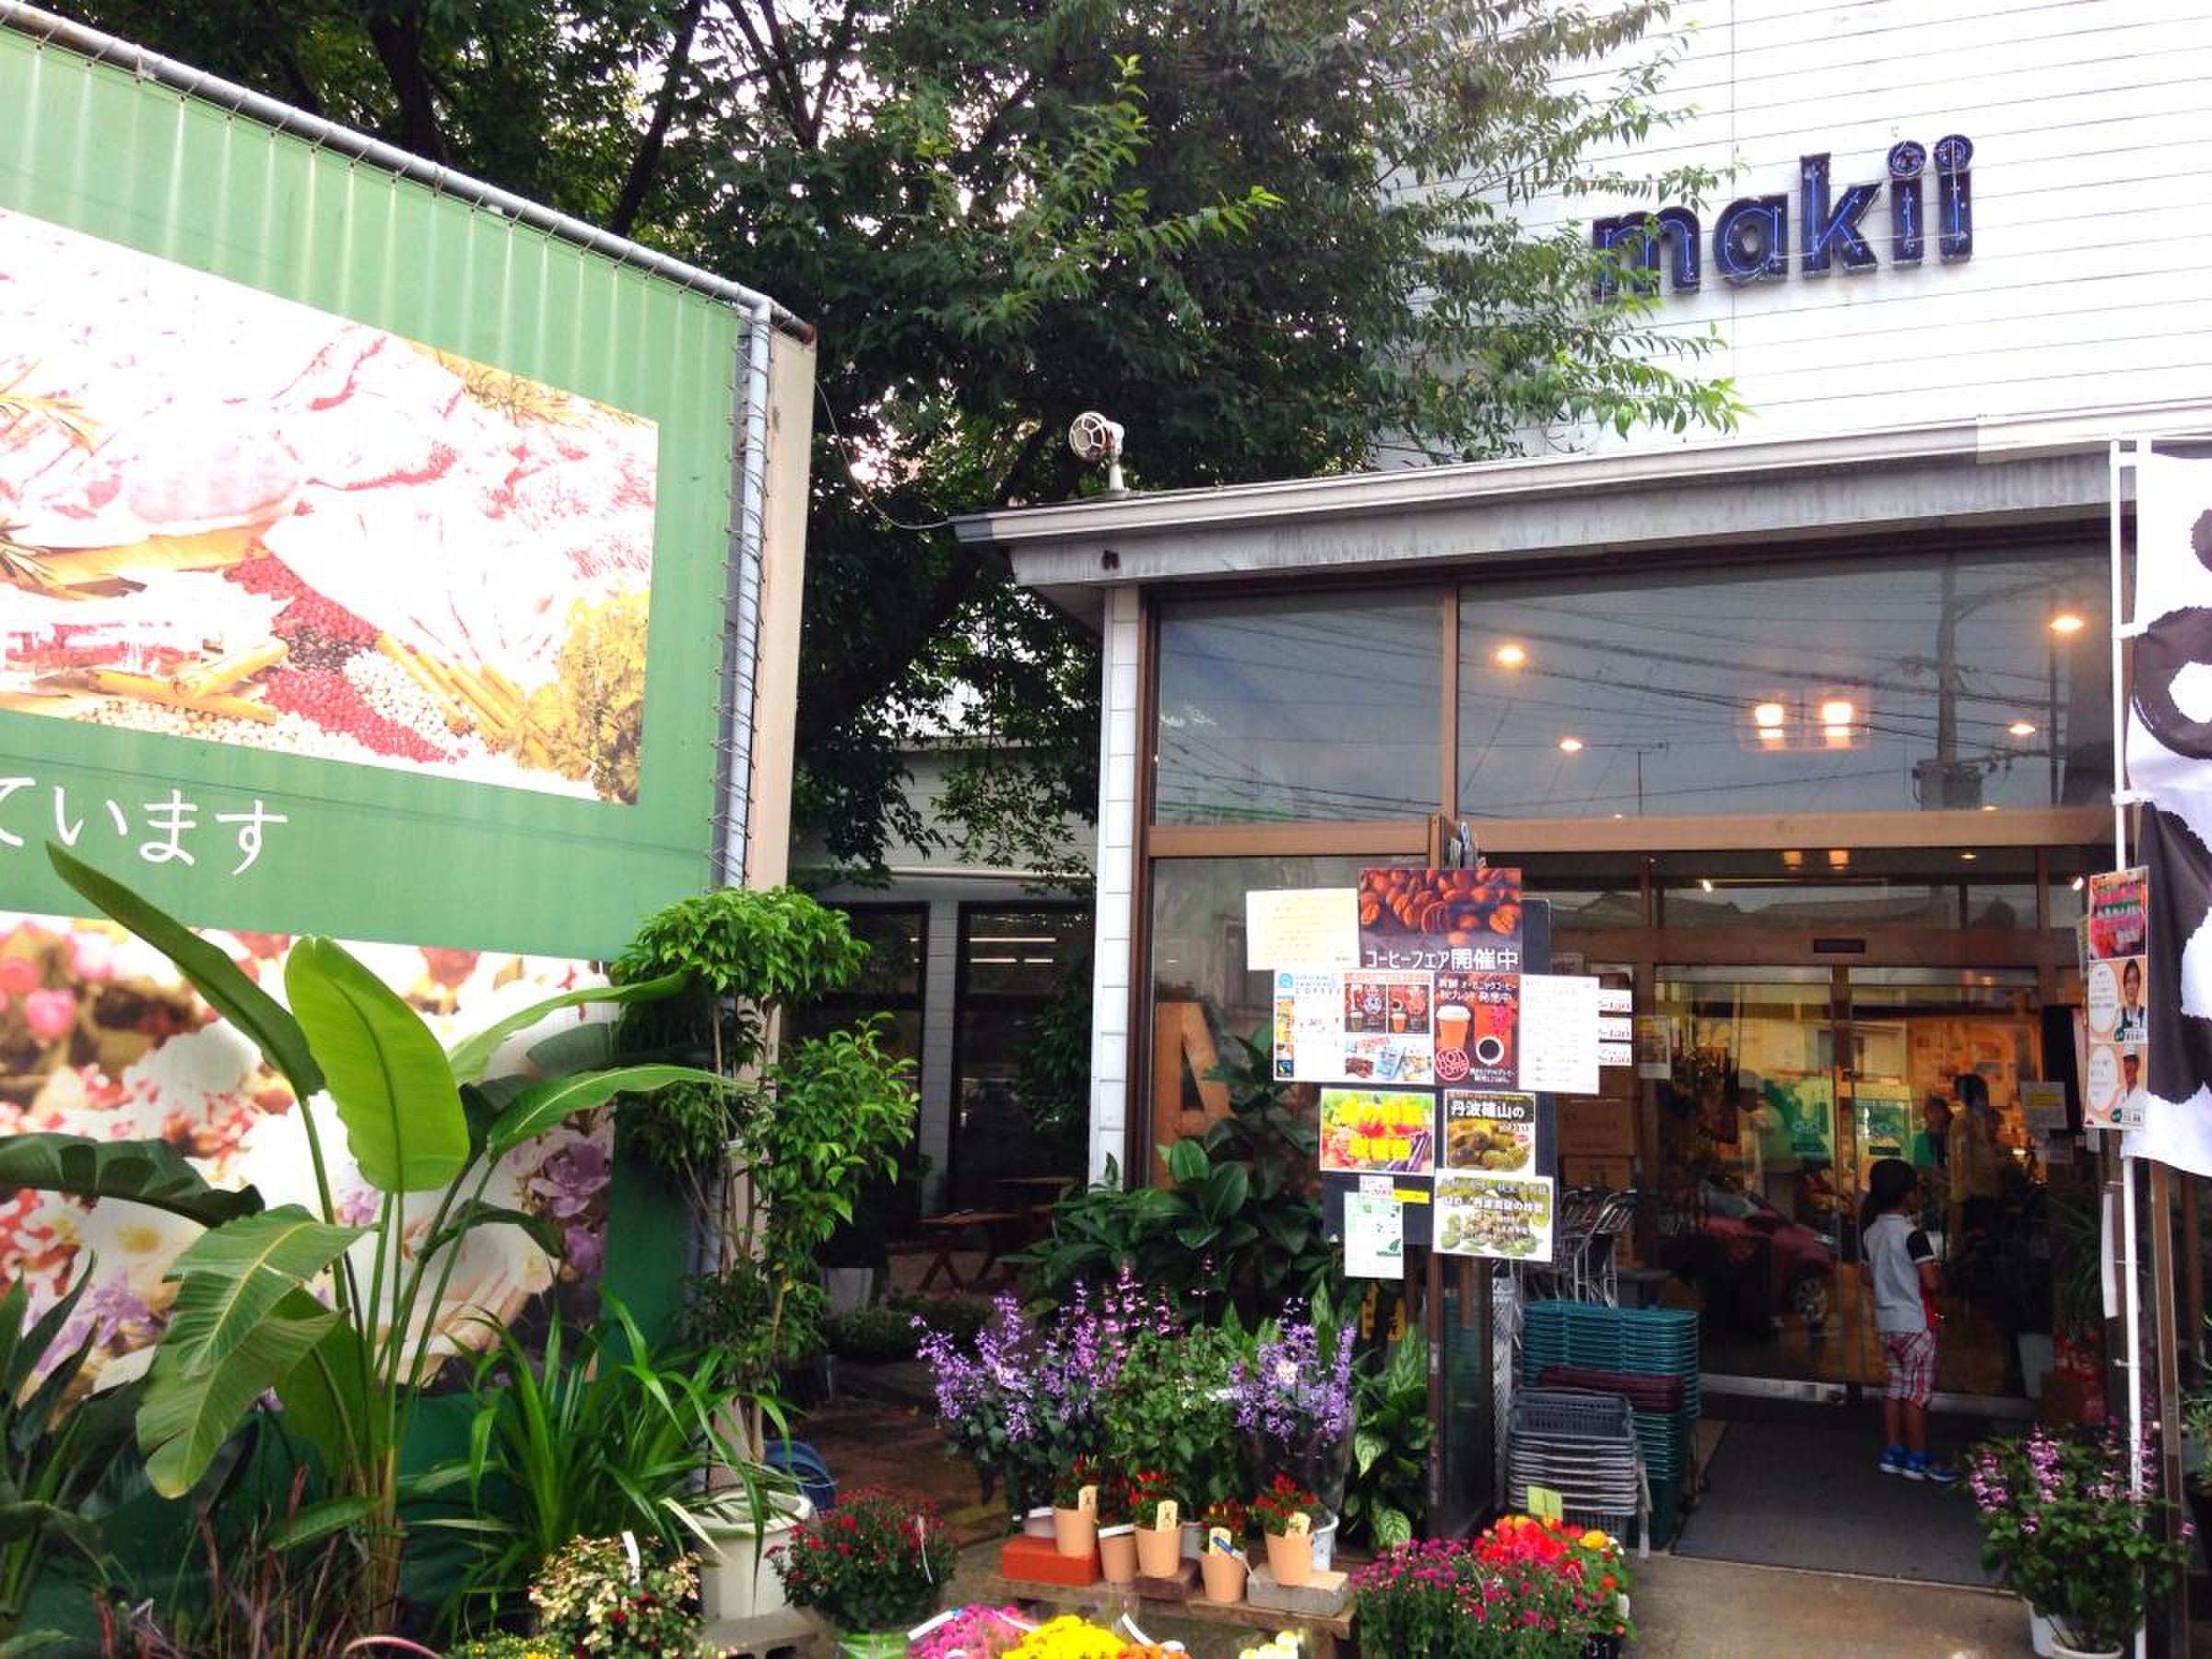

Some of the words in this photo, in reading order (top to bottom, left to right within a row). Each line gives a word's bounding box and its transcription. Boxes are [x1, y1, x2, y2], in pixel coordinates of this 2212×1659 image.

[0, 777, 288, 876] ています
[1365, 947, 1520, 971] コーヒーフェア開催中
